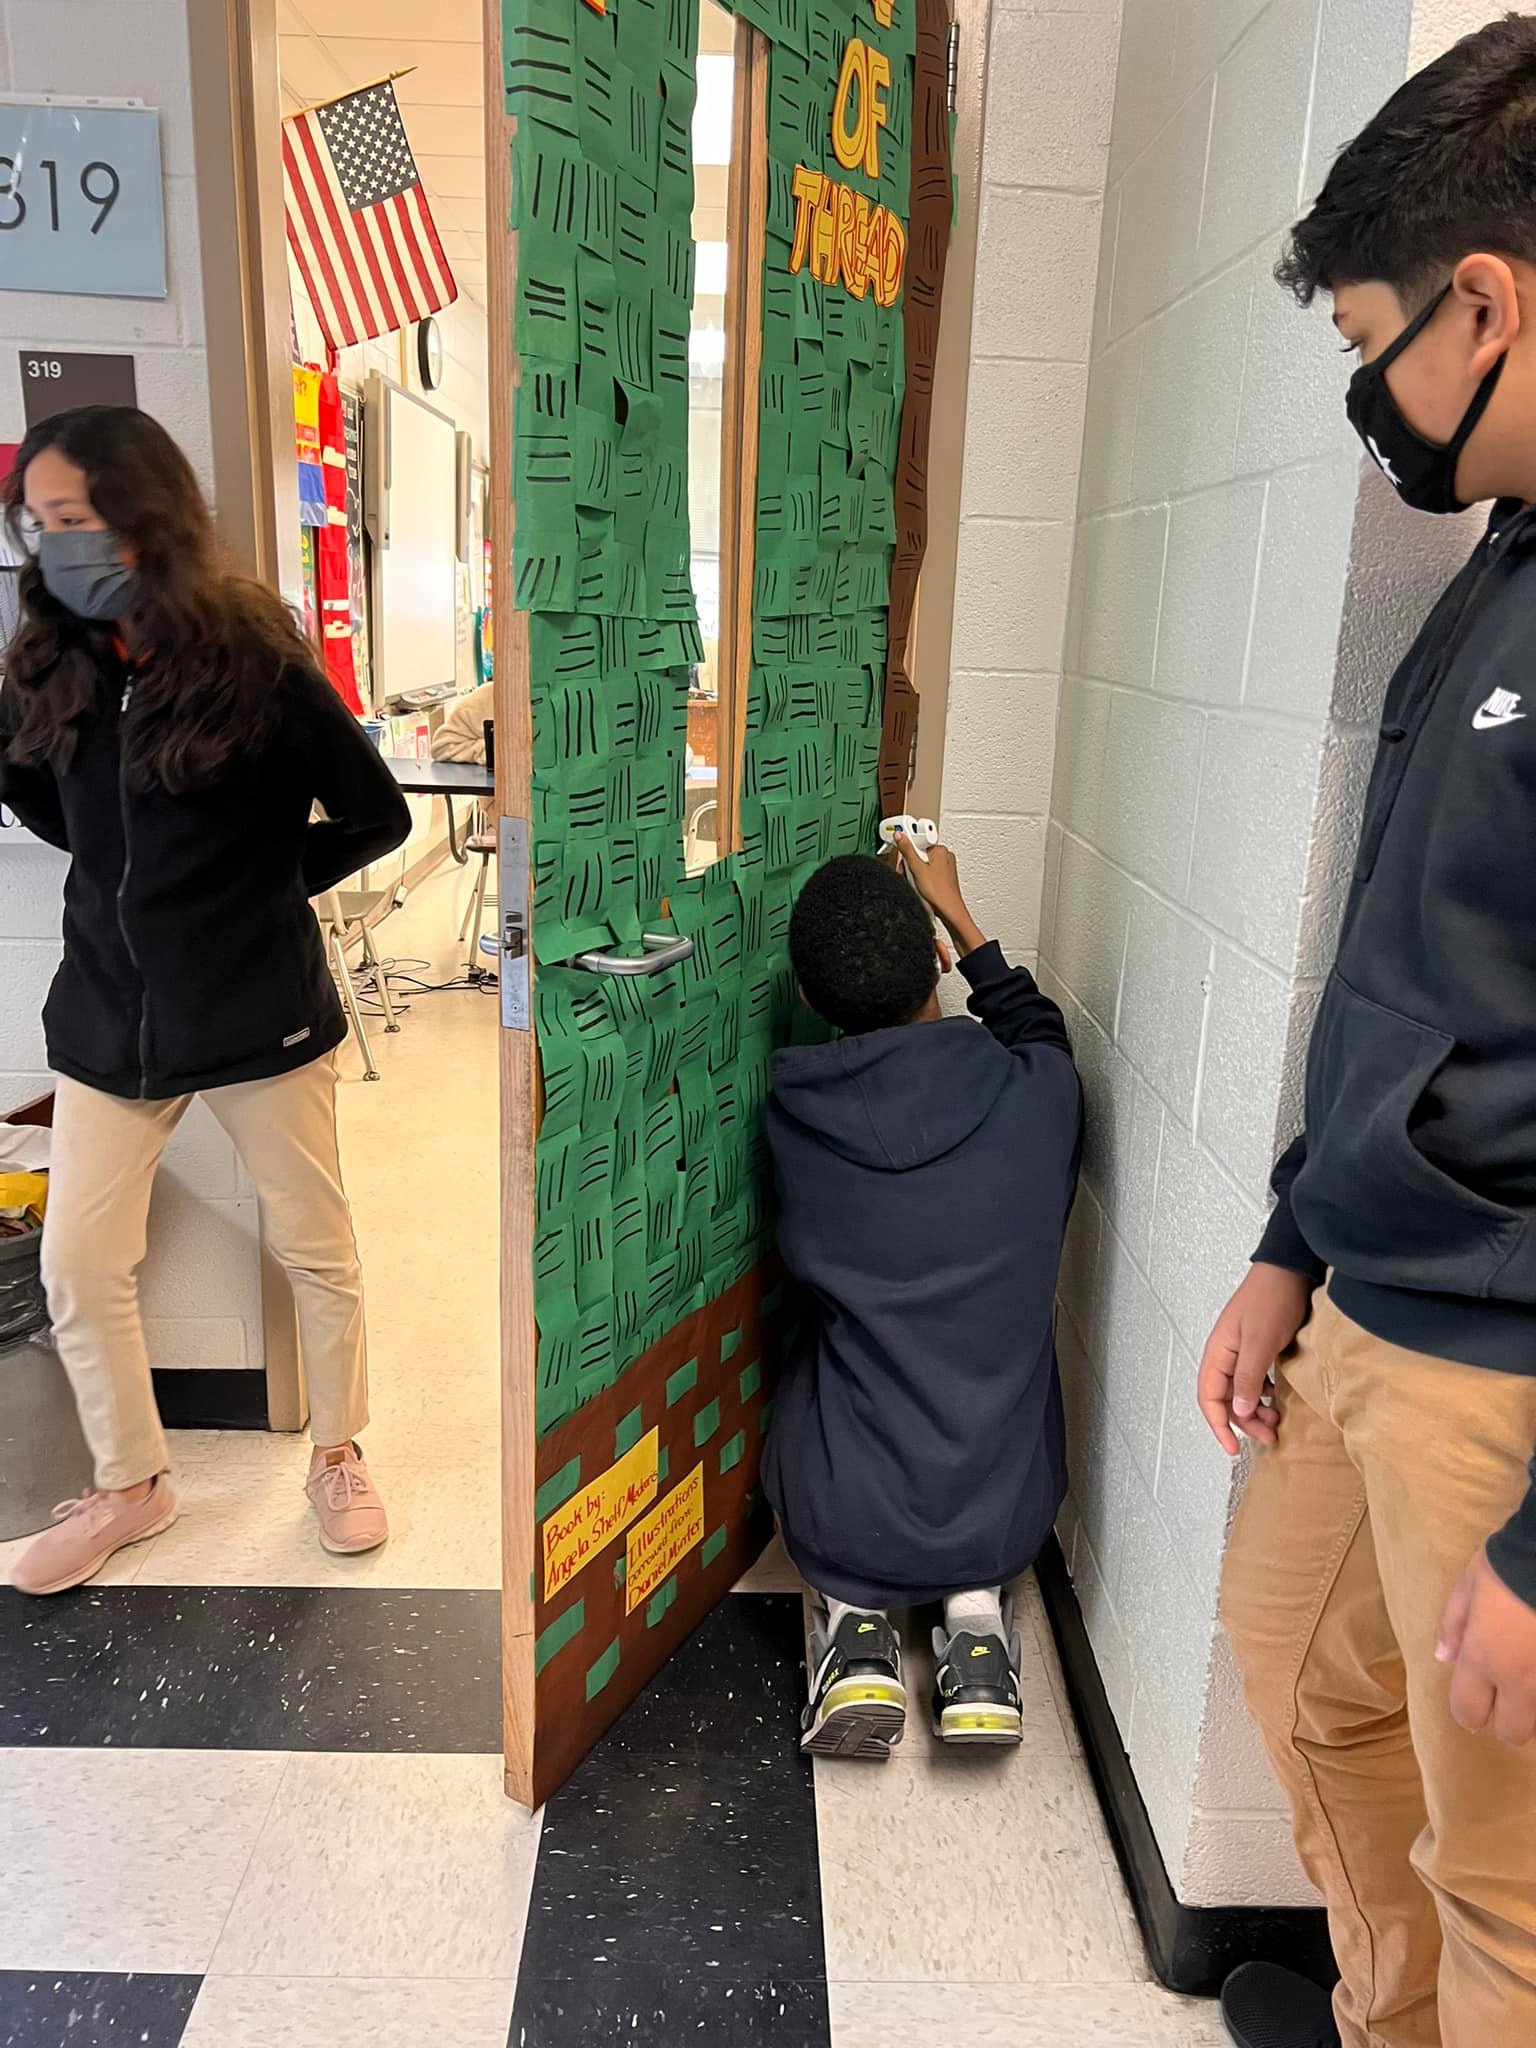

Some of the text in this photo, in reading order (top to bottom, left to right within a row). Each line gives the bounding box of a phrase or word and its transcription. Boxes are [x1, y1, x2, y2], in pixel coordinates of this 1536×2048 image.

[831, 38, 891, 178] OF
[789, 163, 906, 307] THREAD
[27, 360, 62, 378] 319
[546, 1490, 606, 1560] Book by:
[546, 1538, 590, 1594] Angela
[592, 1496, 625, 1543] Shelf
[628, 1476, 699, 1571] Illustrations
[629, 1517, 703, 1611] Daniel Minter
